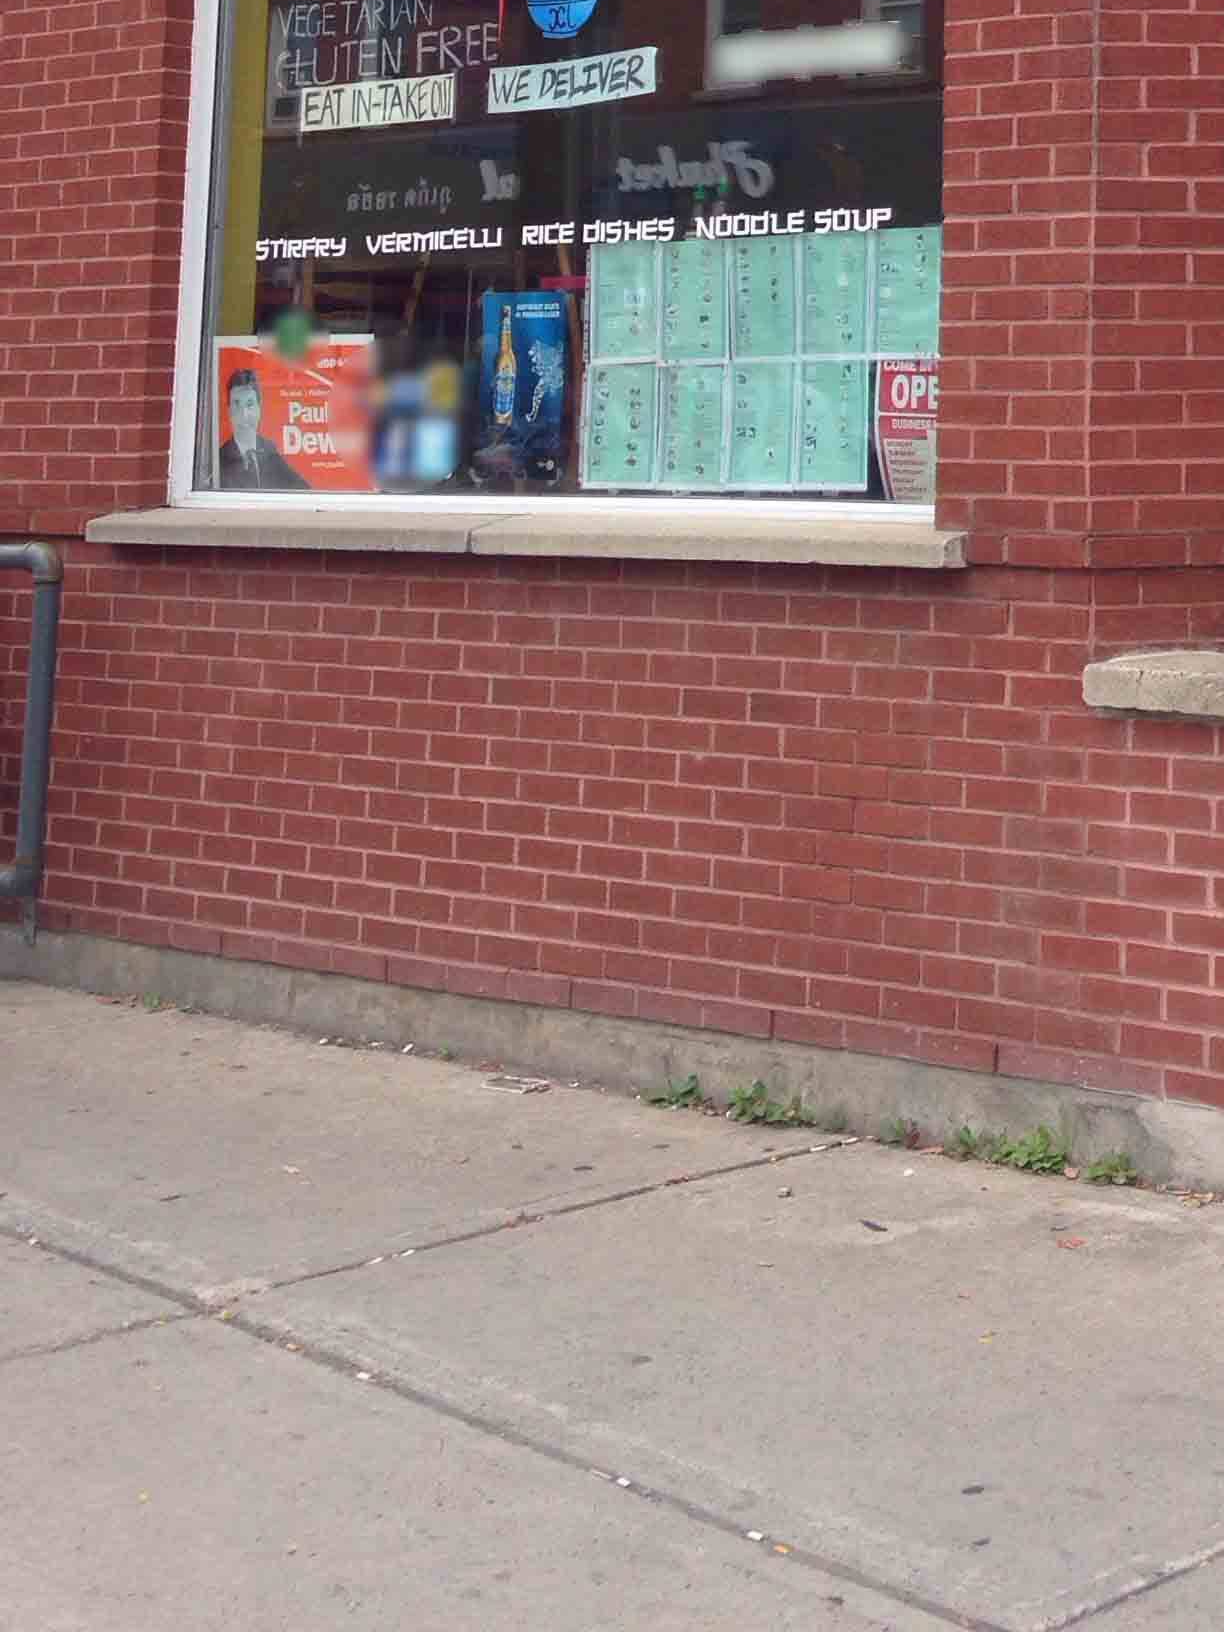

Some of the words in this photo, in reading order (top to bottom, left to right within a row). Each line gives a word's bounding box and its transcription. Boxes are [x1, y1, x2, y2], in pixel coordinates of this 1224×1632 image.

[277, 35, 401, 89] GLUTEN
[416, 22, 500, 73] FREE
[490, 69, 530, 105] WE
[540, 55, 646, 98] DELIVER
[304, 86, 342, 127] EAT
[256, 237, 347, 260] STIRFRY
[365, 227, 503, 255] VERMICELLI
[522, 220, 575, 246] RICE
[582, 217, 675, 244] DISHES
[695, 211, 805, 241] NOODLE
[813, 206, 893, 234] SOUP
[891, 374, 939, 410] OPE
[288, 401, 329, 425] Paul
[282, 426, 342, 456] Dew
